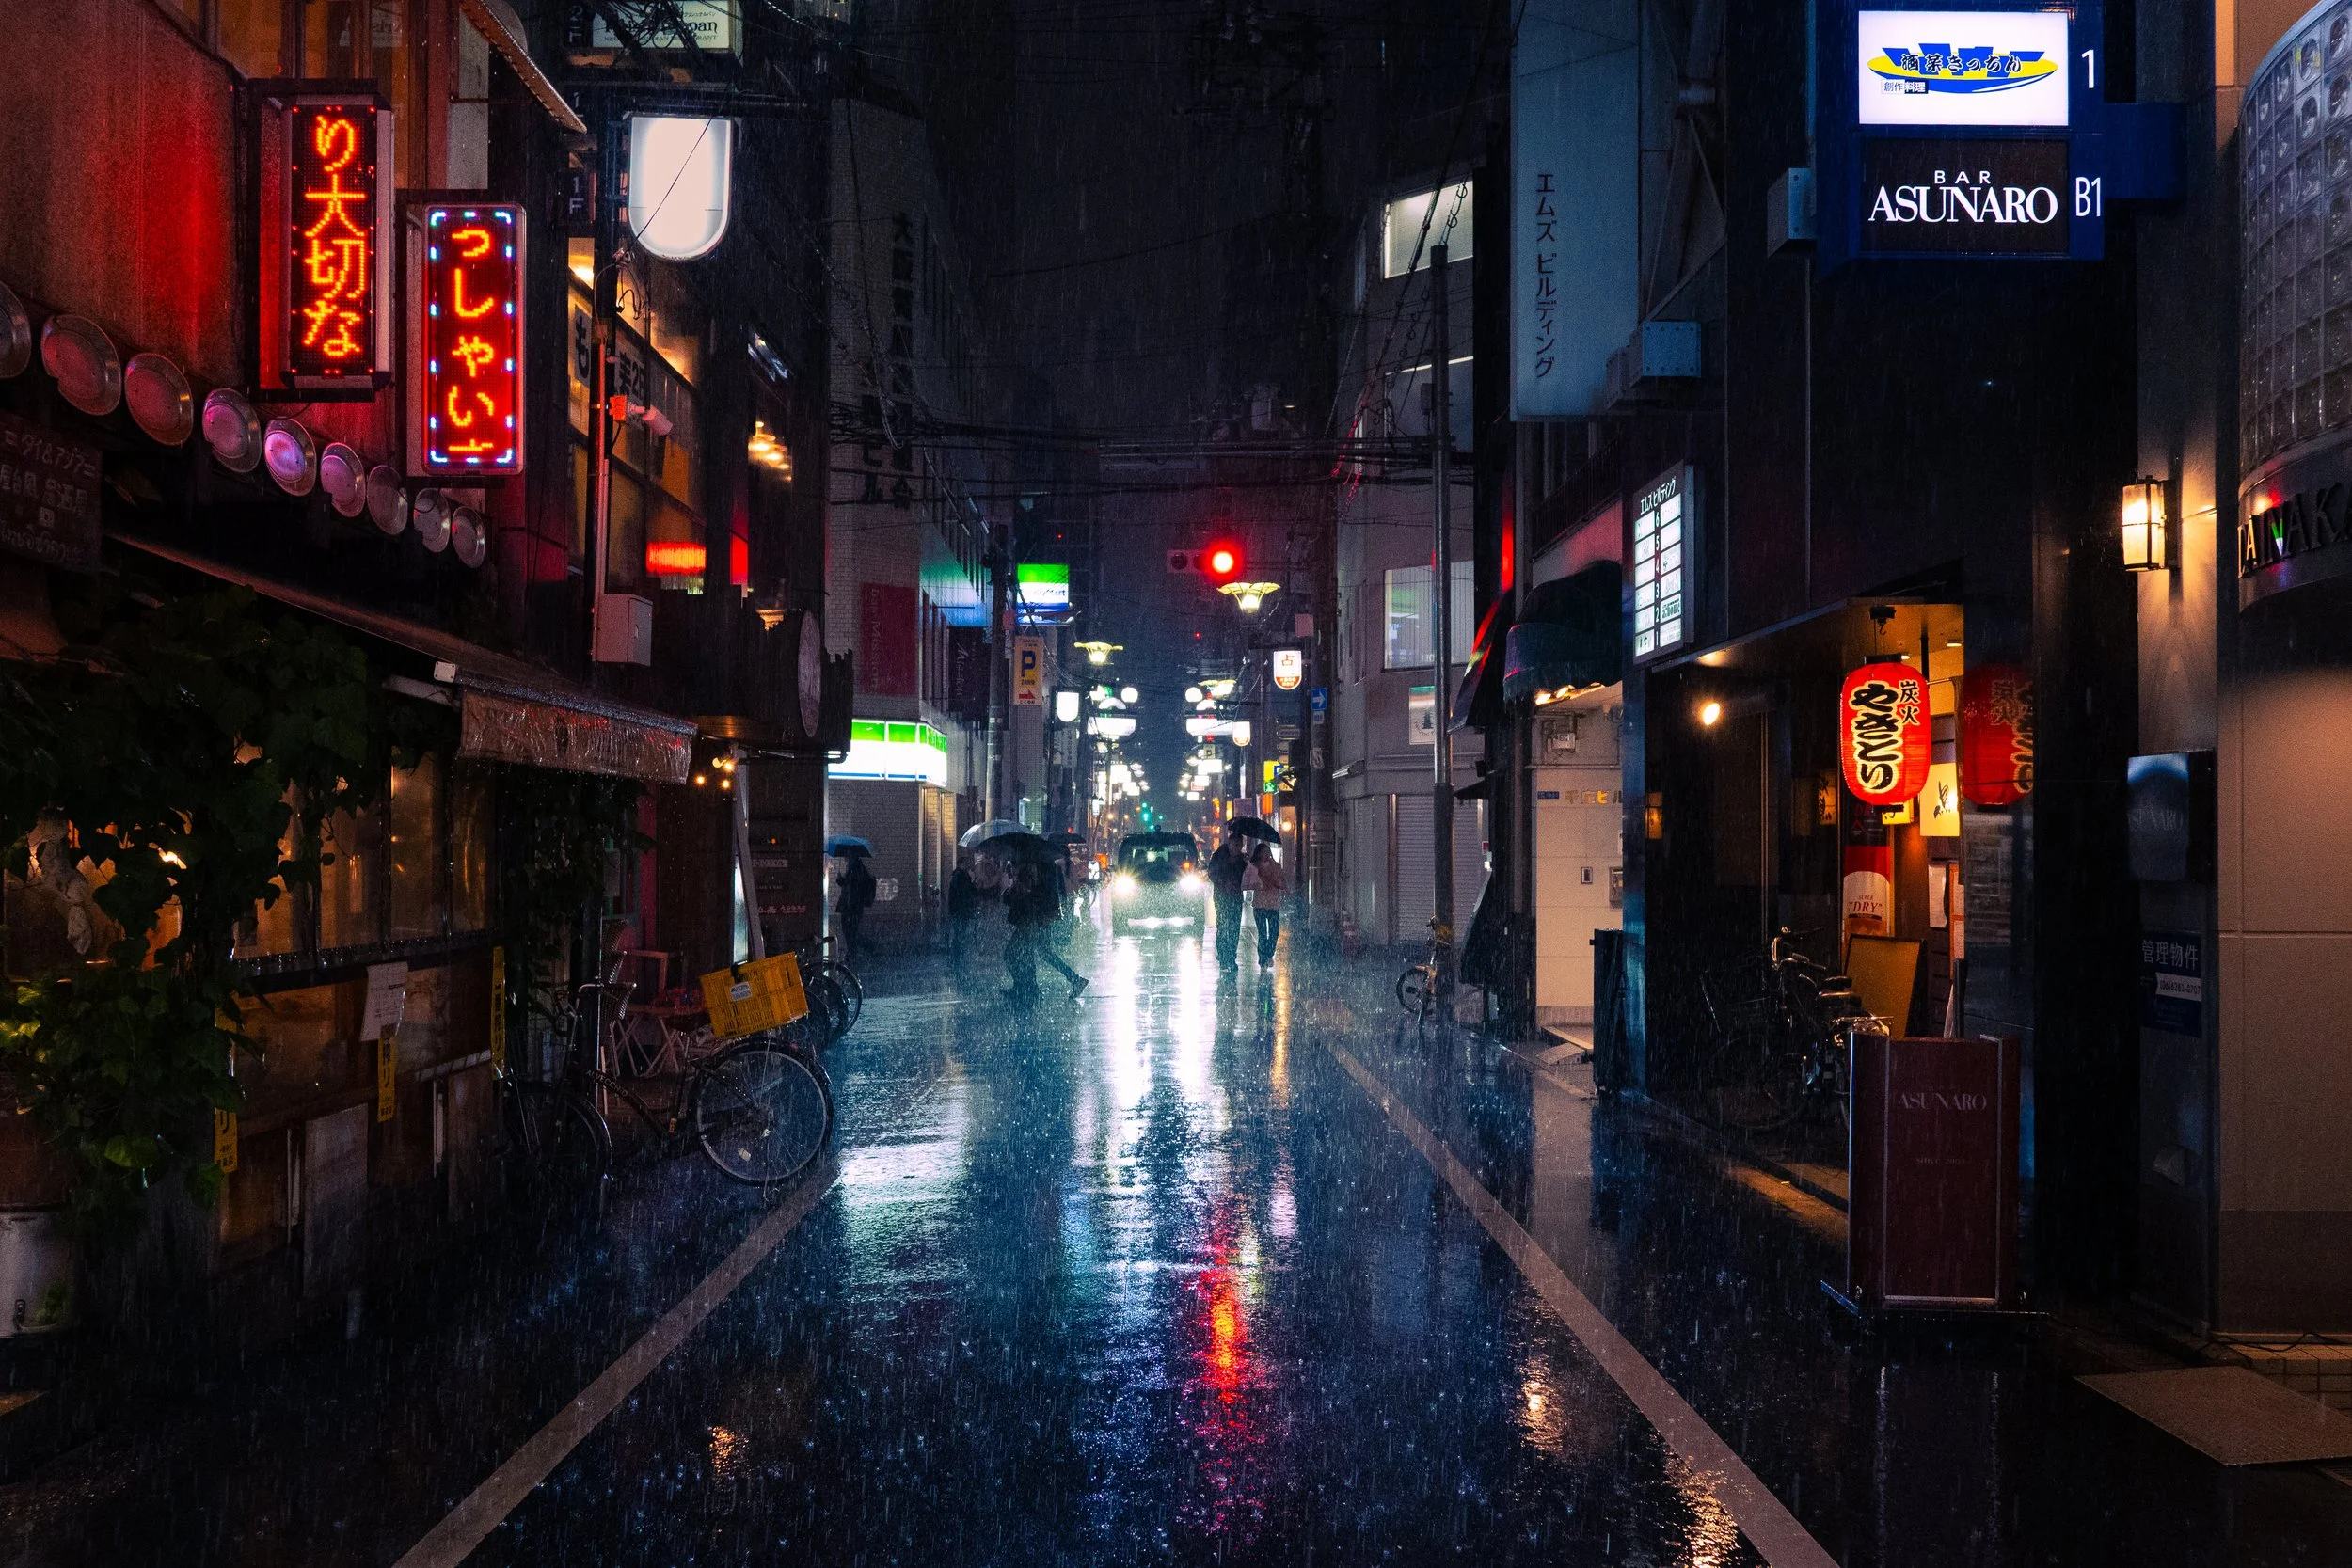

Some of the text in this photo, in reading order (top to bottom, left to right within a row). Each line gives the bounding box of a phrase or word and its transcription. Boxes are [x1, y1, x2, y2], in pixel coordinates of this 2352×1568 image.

[1883, 81, 1926, 93] 創作料理
[2081, 49, 2095, 89] 1
[568, 176, 585, 214] 1F
[1934, 170, 1991, 184] BAR
[1867, 185, 2058, 224] ASUNARO
[2075, 176, 2102, 217] B1
[304, 114, 367, 358] り大切な
[1022, 651, 1036, 677] P
[1899, 680, 1920, 724] 炭火
[1851, 683, 1900, 791] やきとり
[2141, 940, 2199, 970] 管理物件
[1899, 1092, 1988, 1111] ASUNARO
